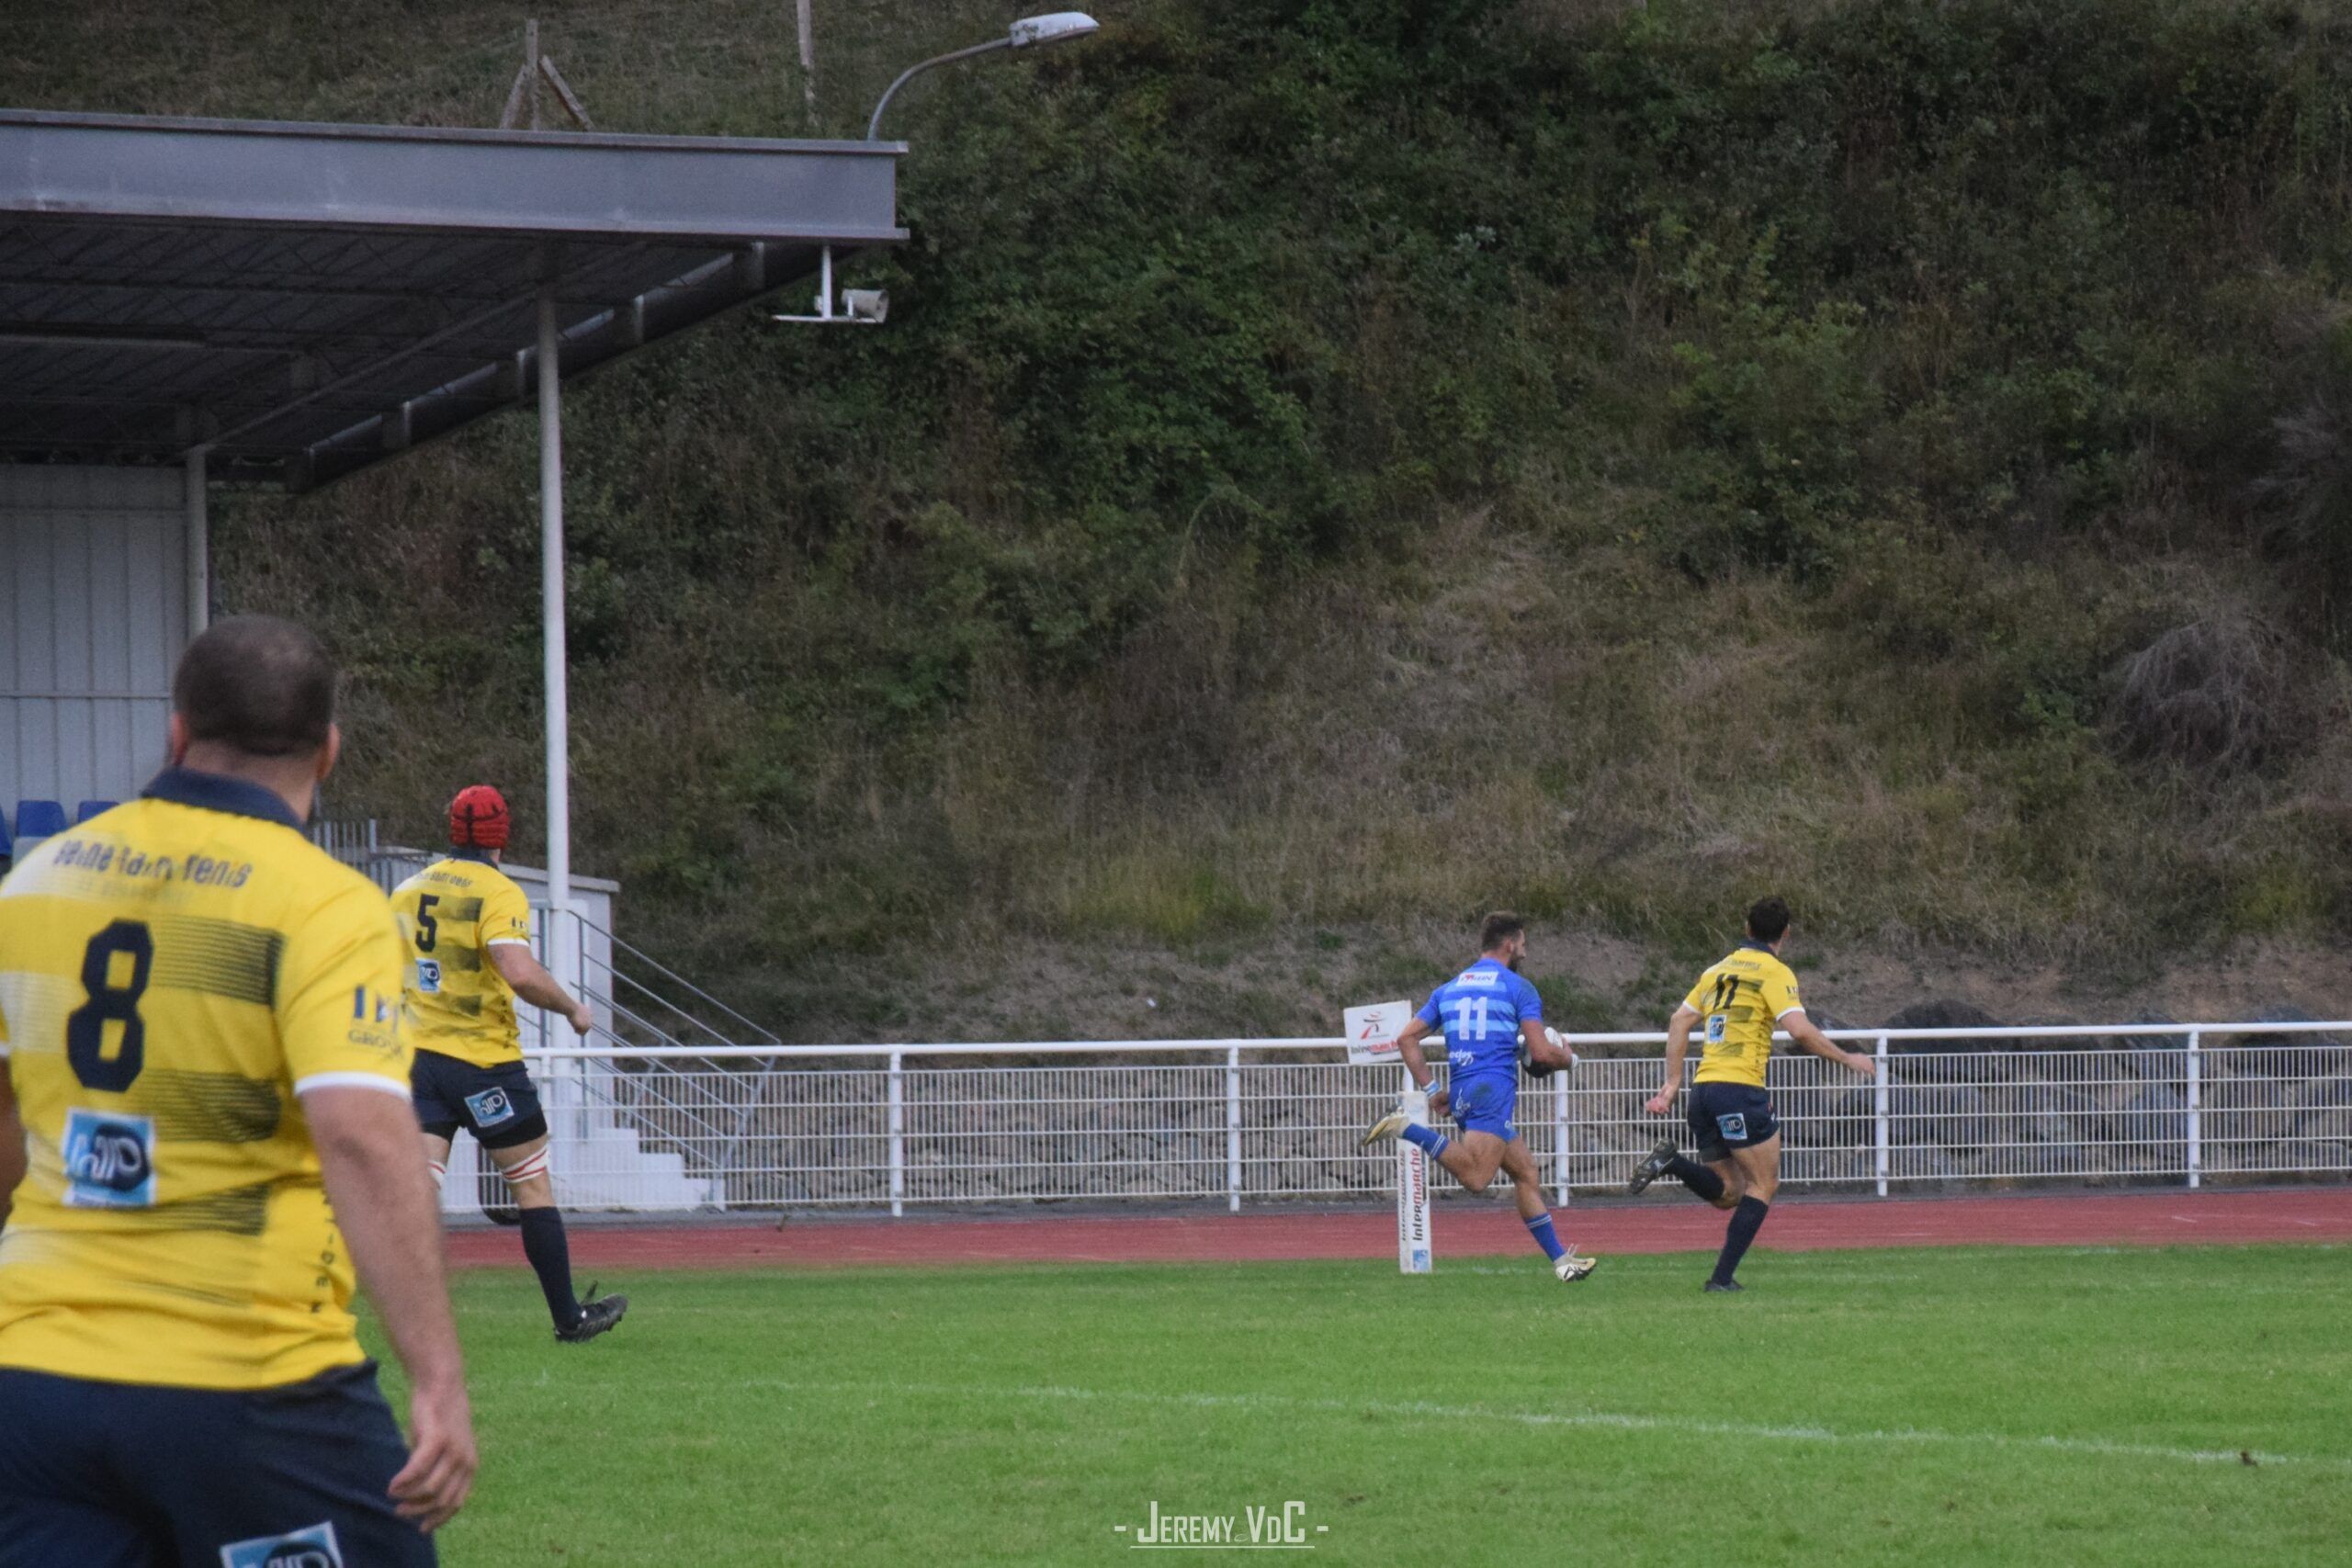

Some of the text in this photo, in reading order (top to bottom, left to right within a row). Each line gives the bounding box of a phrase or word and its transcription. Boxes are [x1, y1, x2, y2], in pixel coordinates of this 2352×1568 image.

[415, 894, 440, 952] 5
[67, 919, 153, 1092] 8
[1454, 997, 1487, 1040] 11
